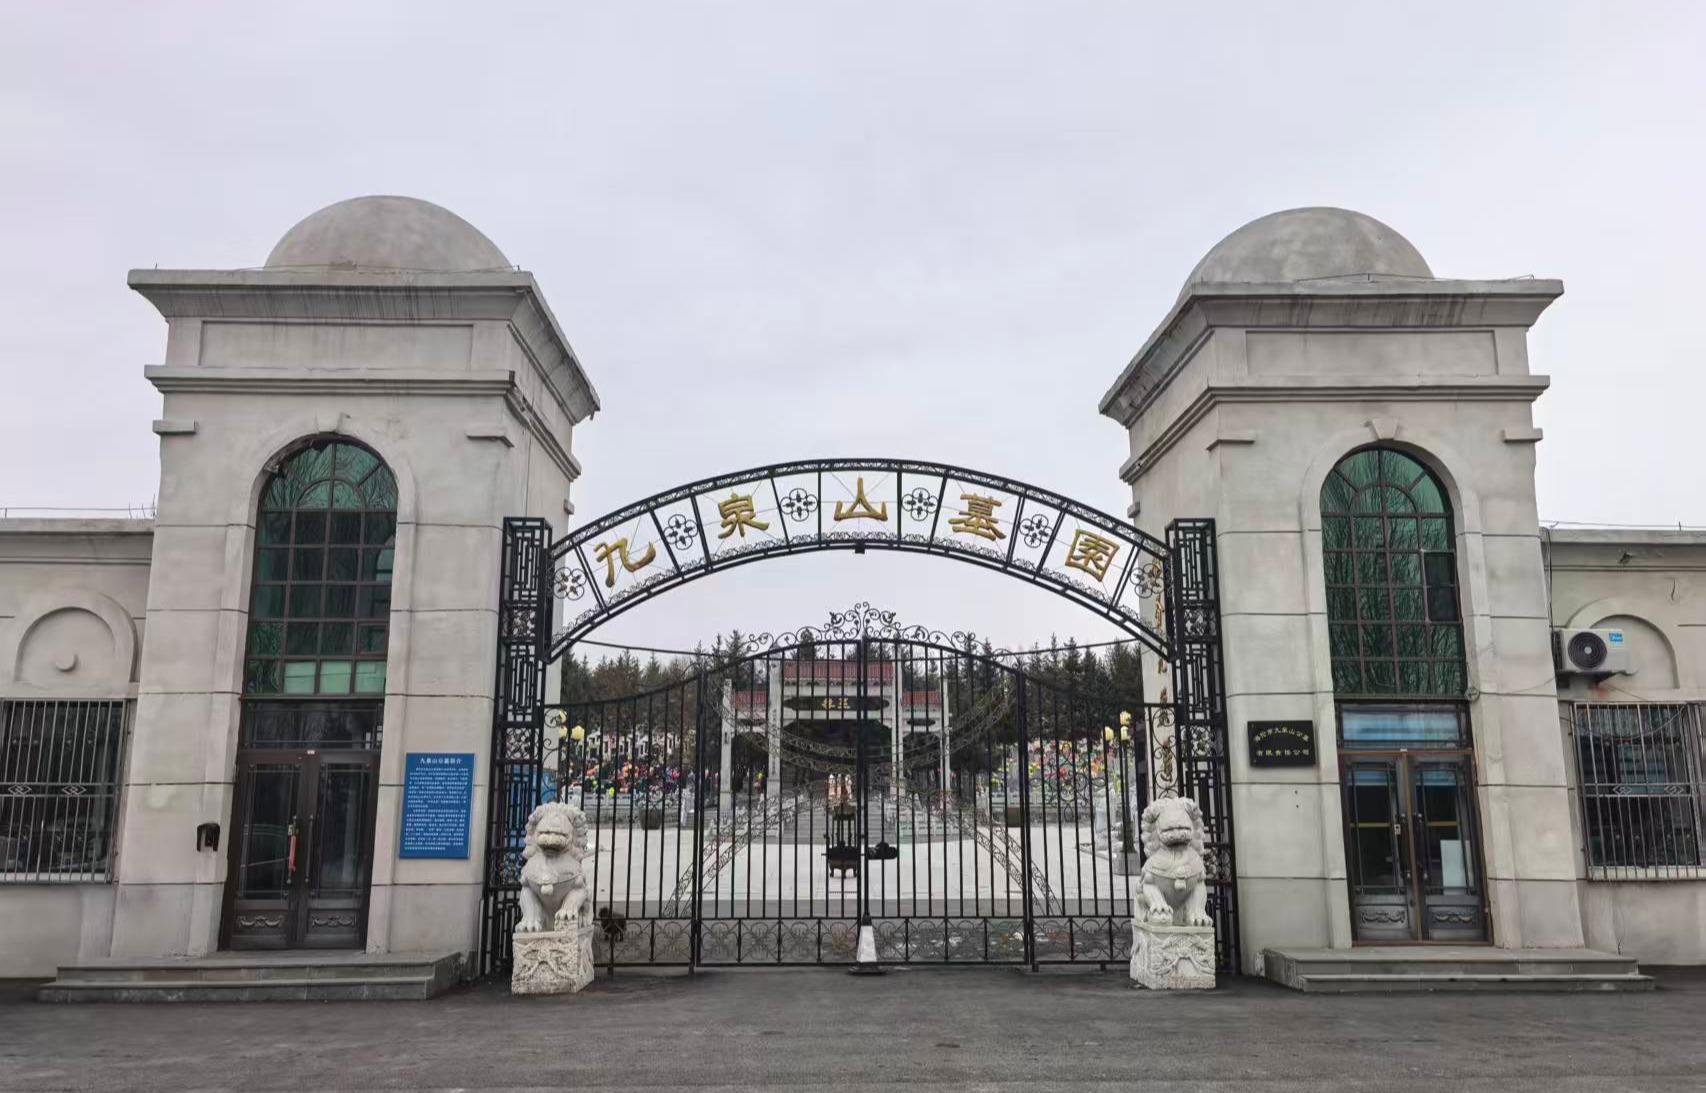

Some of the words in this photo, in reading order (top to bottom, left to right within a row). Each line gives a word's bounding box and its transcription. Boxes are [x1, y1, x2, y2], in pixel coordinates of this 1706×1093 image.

[594, 477, 1120, 587] 九泉山墓园
